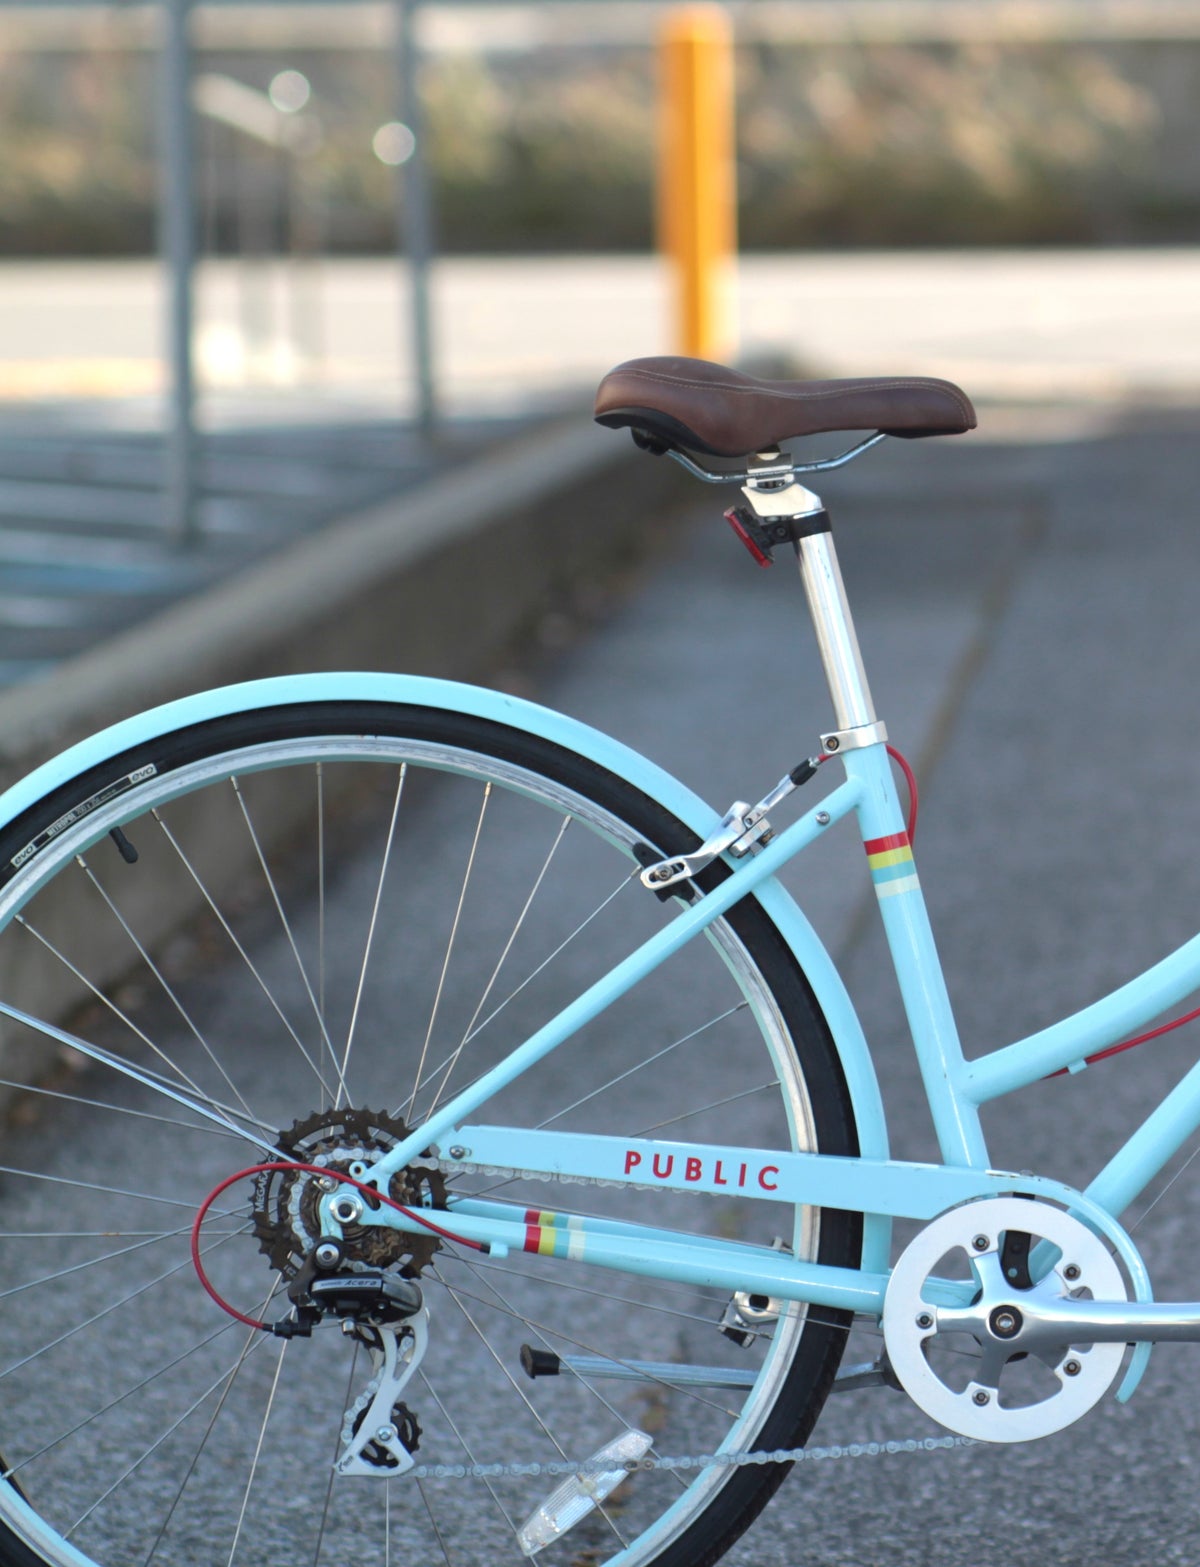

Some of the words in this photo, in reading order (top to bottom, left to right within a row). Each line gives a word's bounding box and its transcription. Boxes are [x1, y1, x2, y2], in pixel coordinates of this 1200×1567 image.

[132, 766, 154, 781] evo
[14, 845, 34, 865] evo
[624, 1150, 780, 1191] PUBLIC
